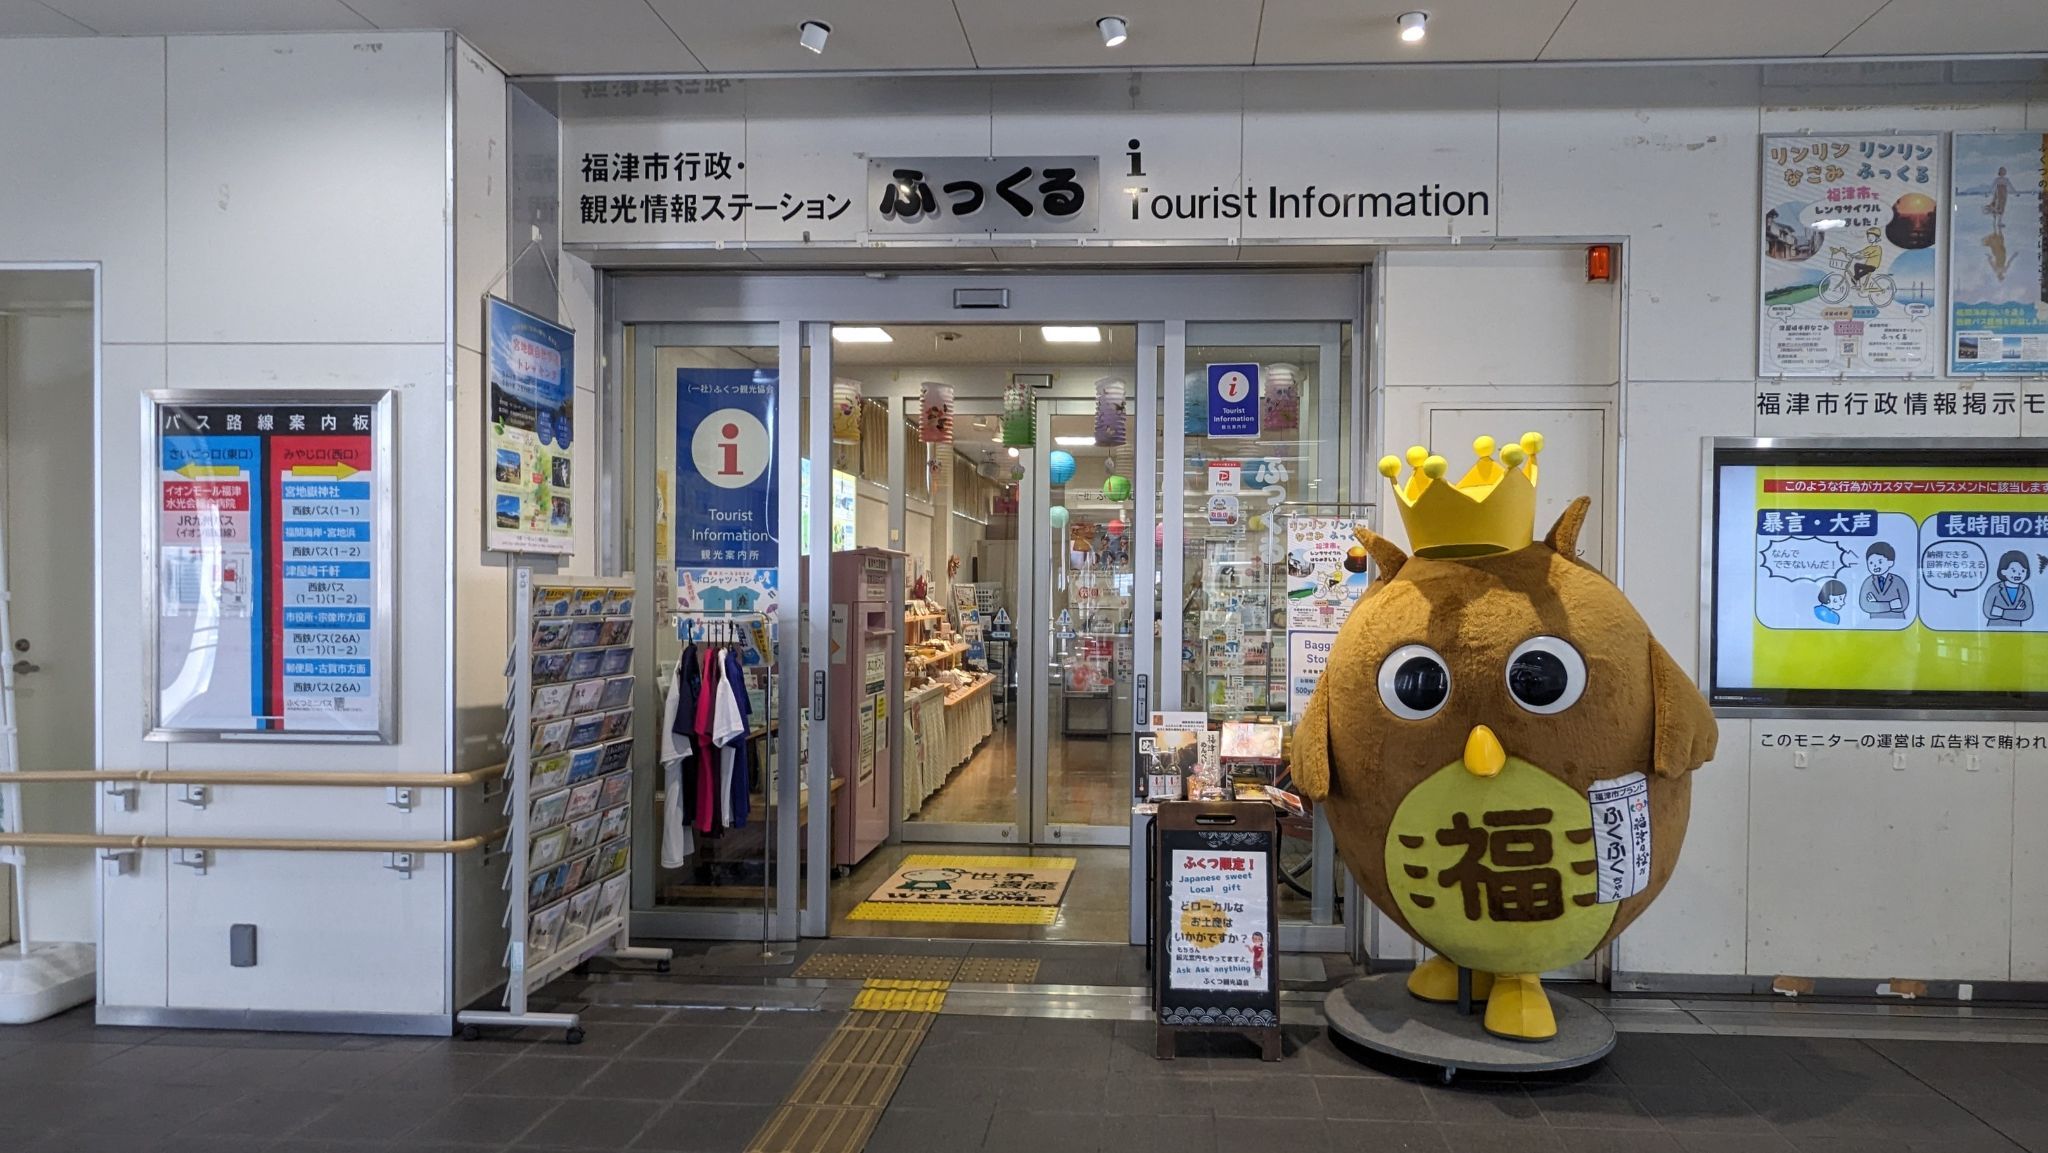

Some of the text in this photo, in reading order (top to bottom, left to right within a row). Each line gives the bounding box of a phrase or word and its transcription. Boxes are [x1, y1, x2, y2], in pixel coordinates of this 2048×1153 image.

[1771, 141, 1933, 166] リンリン リンリン
[581, 151, 745, 182] 福津市行政・
[1784, 162, 1930, 187] なごみ ふっくる
[879, 166, 1085, 218] ふっくる
[1826, 186, 1880, 202] 福津市で
[580, 193, 851, 224] 観光情報ステーション
[1122, 184, 1489, 220] Tourist Information
[1815, 204, 1881, 215] レンタサイクル
[1757, 391, 2045, 416] 福津市行政情報掲示モ
[1222, 407, 1246, 415] Tourist
[166, 413, 370, 432] バス路線案内板
[166, 485, 242, 497] イオンモール福津
[708, 508, 753, 521] Tourist
[1762, 512, 1872, 533] 暴言・大声
[692, 529, 768, 542] Information
[700, 549, 760, 561] 観光案内所
[1771, 549, 1800, 558] なんで
[1926, 550, 1969, 559] 納得できる
[1774, 559, 1836, 569] できないんだ！
[1926, 560, 1986, 569] 回答がもらえる
[308, 582, 345, 593] 西鉄バス
[1304, 639, 1333, 652] Bagg
[1594, 783, 1646, 801] 福津市ブランド
[1183, 856, 1255, 871] ふくつ限定！
[1435, 807, 1566, 923] 福
[1178, 872, 1253, 884] Japanese sweet
[1189, 884, 1242, 894] Local gift
[887, 891, 1047, 903] WELCOME
[1180, 901, 1244, 913] どローカルな
[1190, 917, 1234, 928] お土産は
[1174, 931, 1248, 944] いかがですか？
[1177, 946, 1201, 954] もちろん
[1214, 964, 1252, 975] anything
